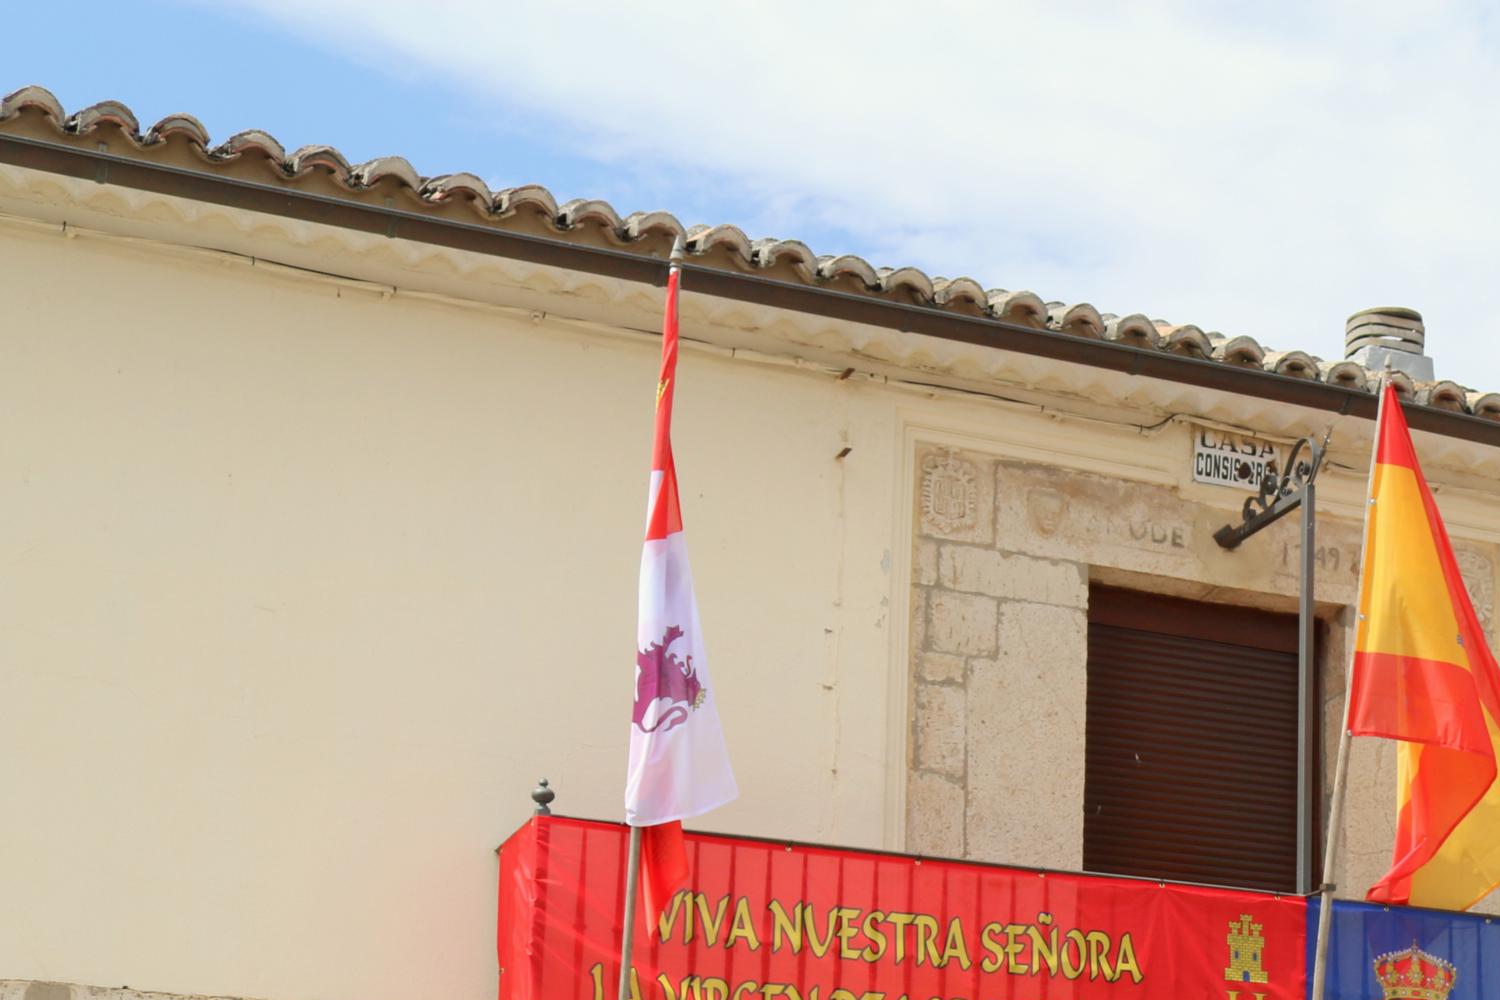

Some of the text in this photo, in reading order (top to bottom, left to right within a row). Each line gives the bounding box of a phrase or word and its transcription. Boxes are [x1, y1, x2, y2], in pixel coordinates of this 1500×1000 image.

[1283, 542, 1340, 572] 149
[658, 889, 1144, 985] VIVA NUESTRA SEÑORA
